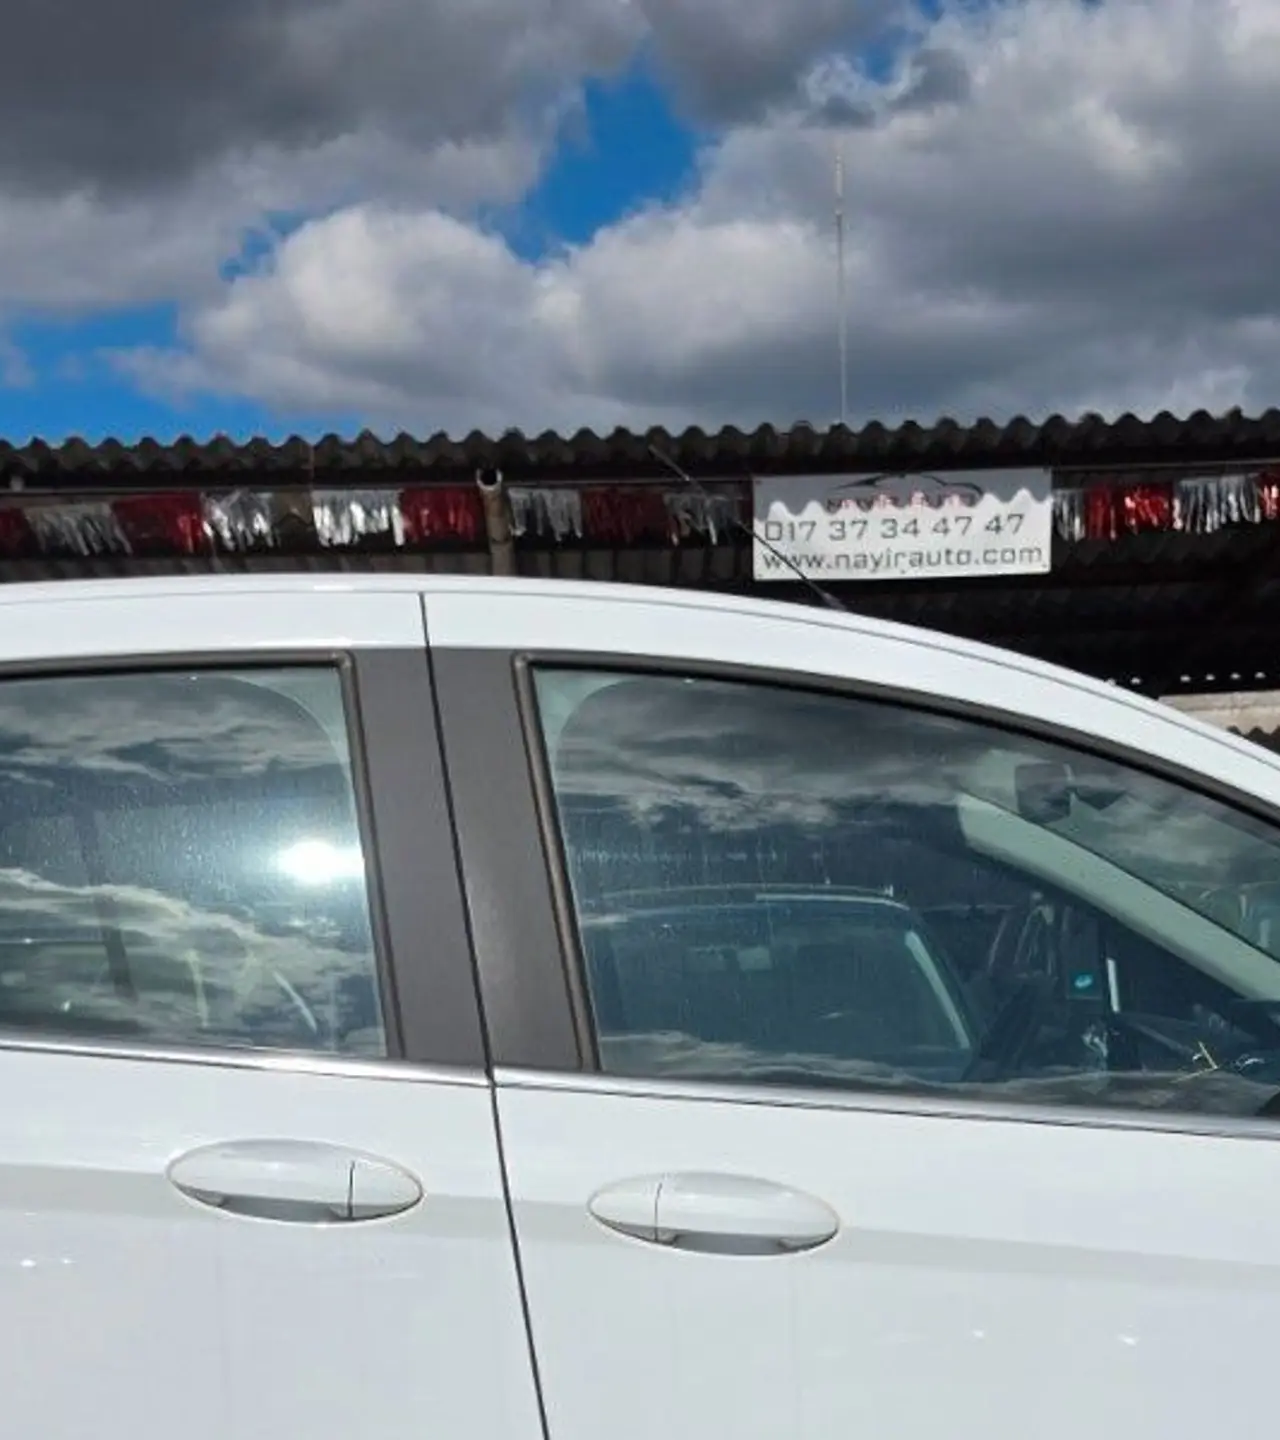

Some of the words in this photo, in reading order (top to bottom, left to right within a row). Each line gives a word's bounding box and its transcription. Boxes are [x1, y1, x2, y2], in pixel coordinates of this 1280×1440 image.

[764, 520, 817, 541] 017
[829, 519, 868, 541] 37
[880, 517, 921, 538] 34
[932, 515, 973, 536] 47
[984, 513, 1024, 535] 47
[762, 546, 1043, 573] www.nayirauto.com
